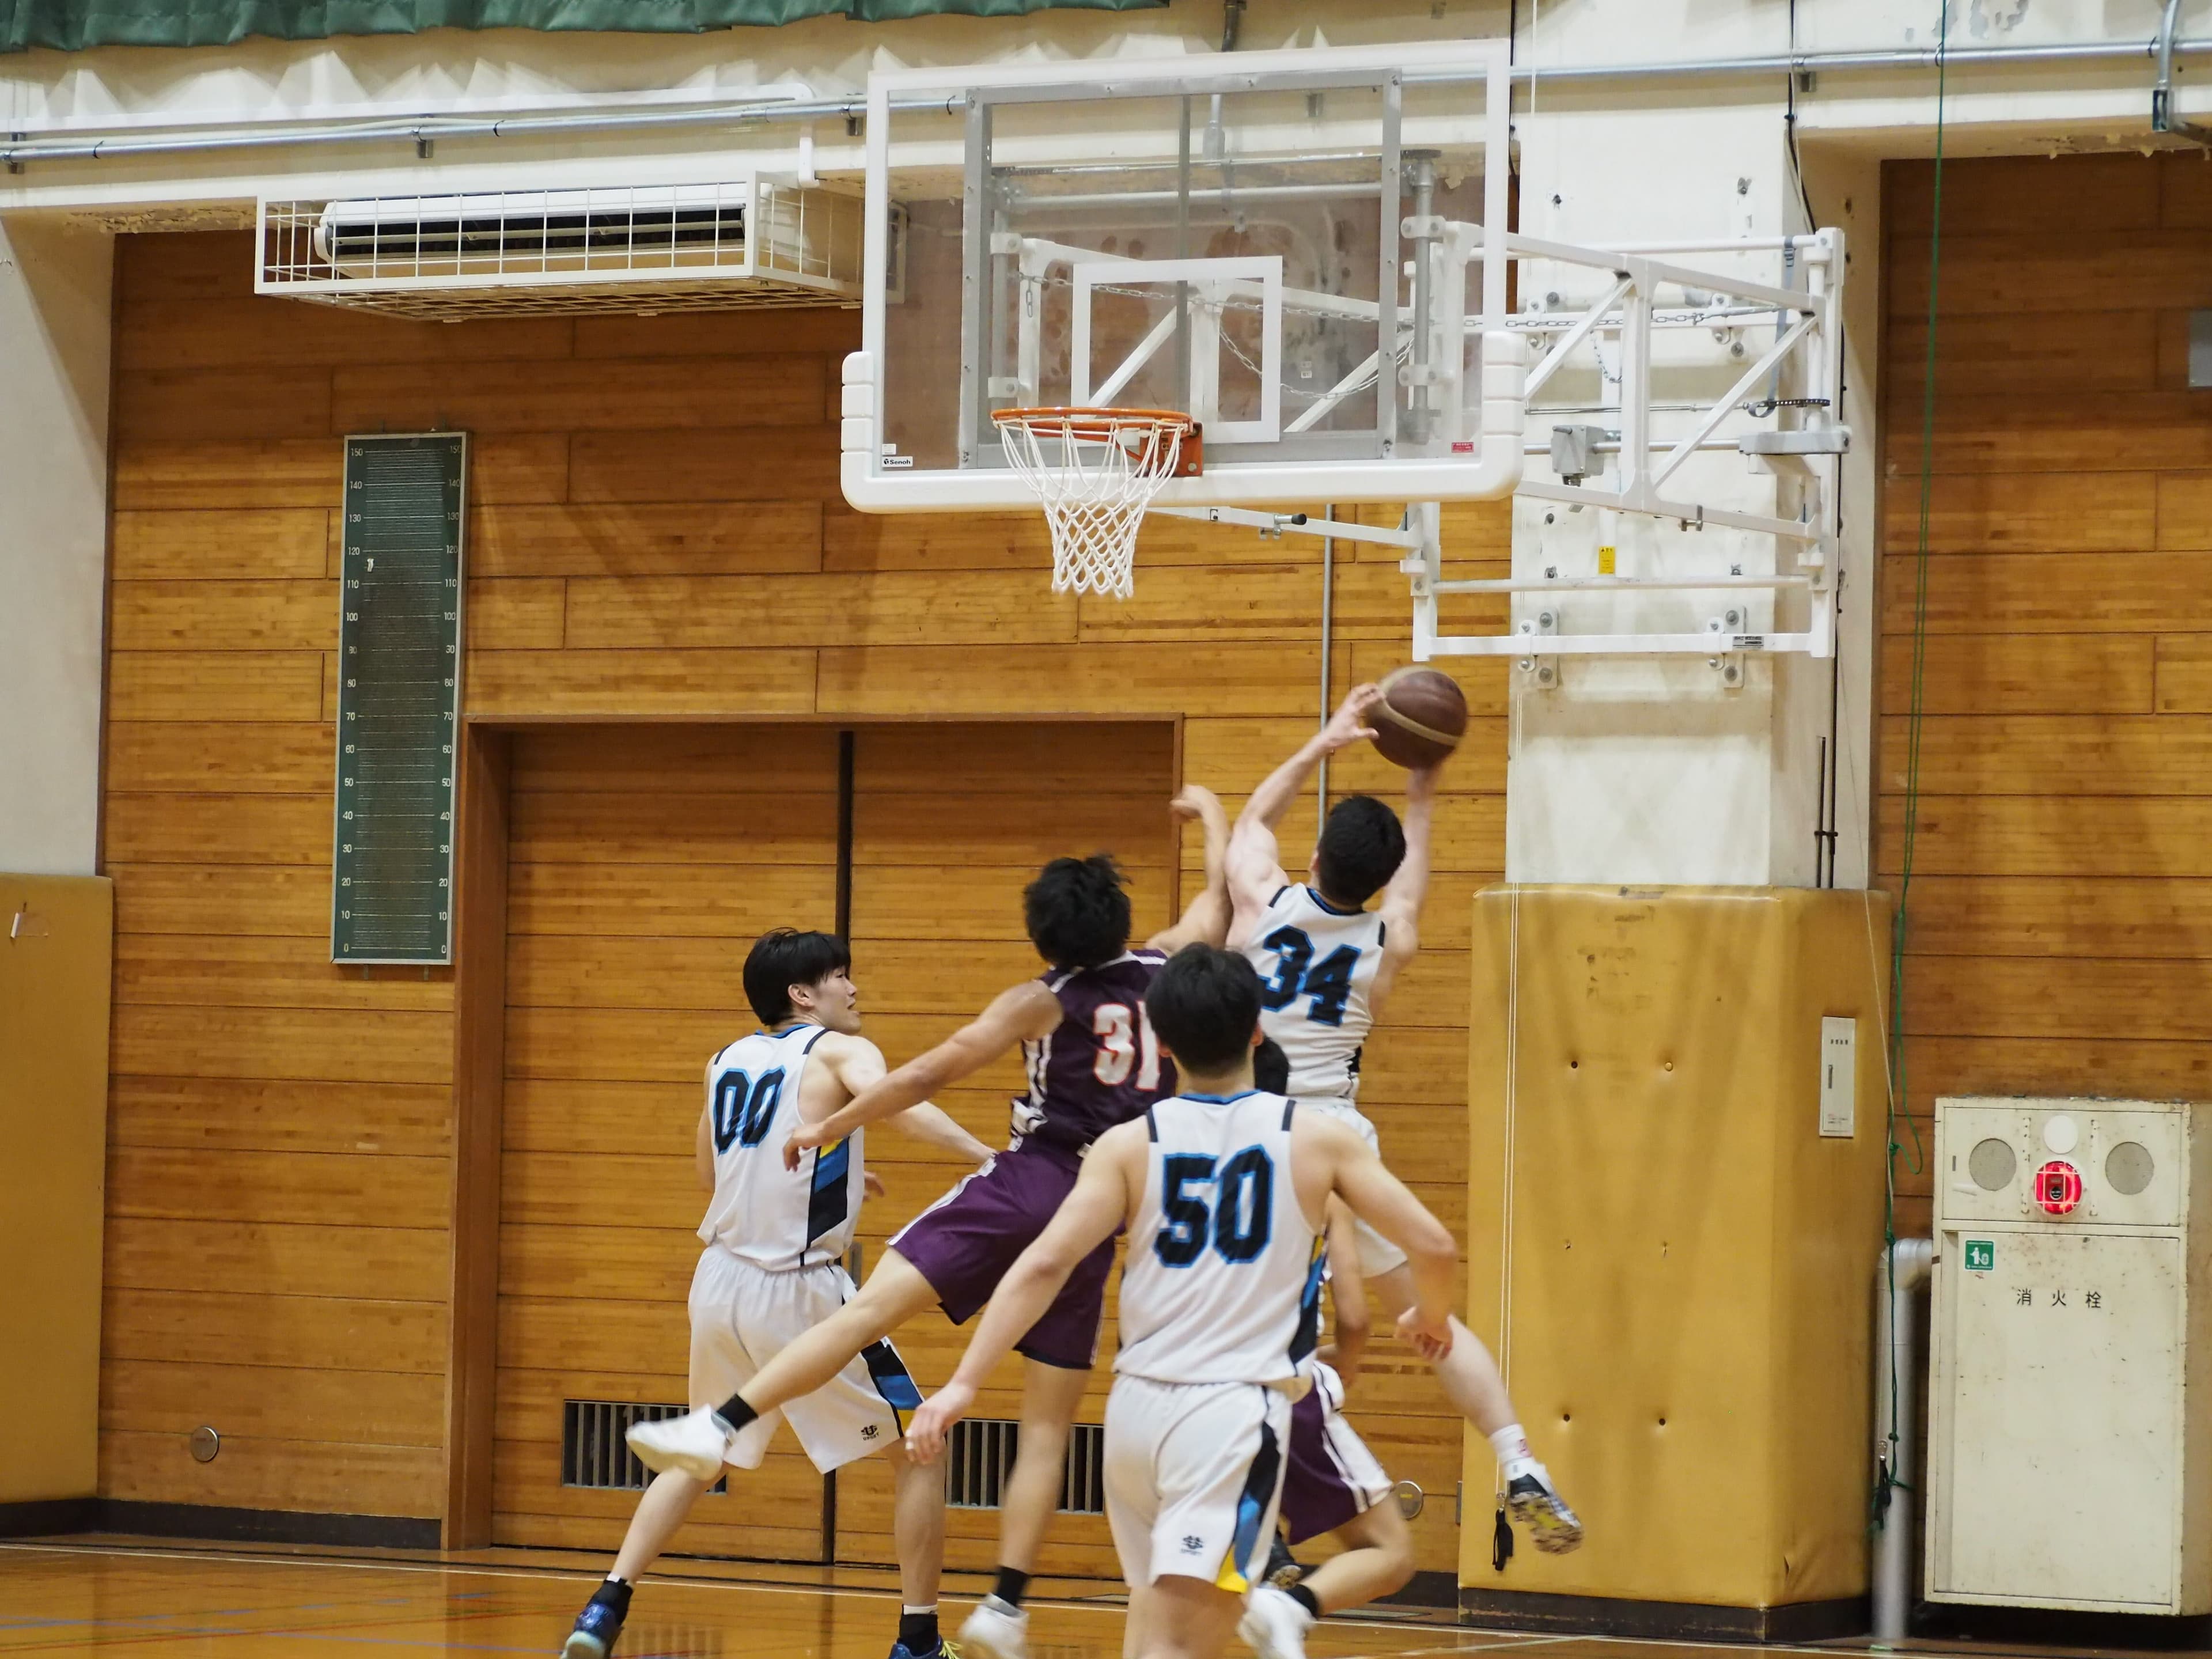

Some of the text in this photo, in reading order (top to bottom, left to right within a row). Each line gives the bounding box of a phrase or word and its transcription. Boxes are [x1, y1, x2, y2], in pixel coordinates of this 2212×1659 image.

[350, 448, 363, 456] 150
[350, 480, 362, 489] 140
[449, 479, 460, 487] 140
[349, 514, 361, 522] 130
[448, 512, 459, 521] 130
[348, 547, 360, 555] 120
[446, 544, 458, 554] 120
[347, 579, 359, 588] 110
[445, 578, 457, 587] 110
[346, 612, 358, 621] 100
[444, 612, 456, 620] 100
[444, 678, 454, 687] 80
[346, 712, 355, 721] 70
[444, 711, 453, 721] 70
[442, 744, 452, 753] 60
[344, 778, 354, 787] 50
[442, 778, 451, 787] 50
[342, 810, 353, 820] 40
[440, 811, 450, 820] 40
[343, 844, 352, 853] 30
[440, 844, 449, 853] 30
[342, 877, 351, 886] 20
[438, 878, 448, 887] 20
[341, 910, 350, 919] 10
[438, 911, 447, 921] 10
[343, 943, 349, 952] 0
[441, 945, 446, 954] 0
[1258, 925, 1362, 1027] 34
[1094, 1001, 1161, 1091] 31
[713, 1065, 786, 1156] 00
[1153, 1143, 1274, 1268] 50
[2017, 1287, 2101, 1308] 消火栓
